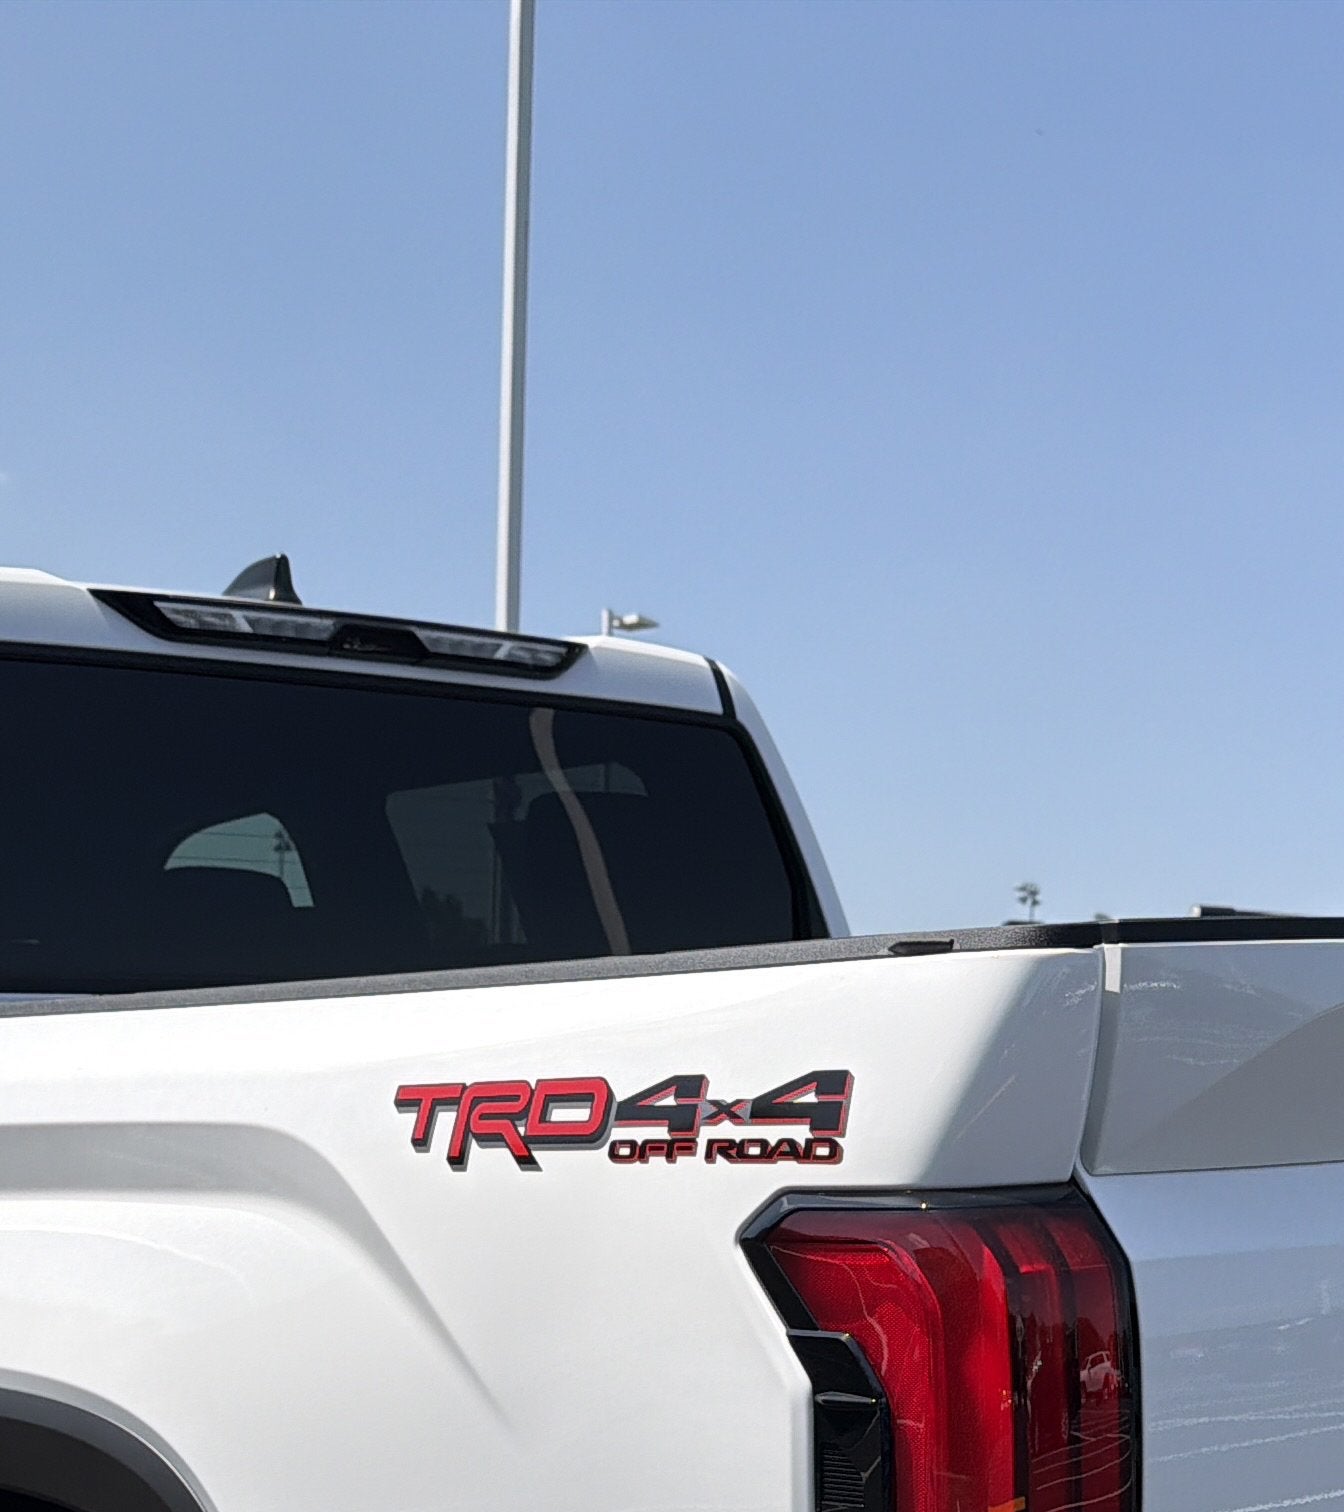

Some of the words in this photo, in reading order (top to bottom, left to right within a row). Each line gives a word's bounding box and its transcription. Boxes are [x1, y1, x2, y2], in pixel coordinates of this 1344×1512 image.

[394, 1077, 616, 1171] TRD
[608, 1138, 697, 1164] OFF
[705, 1137, 844, 1164] ROAD
